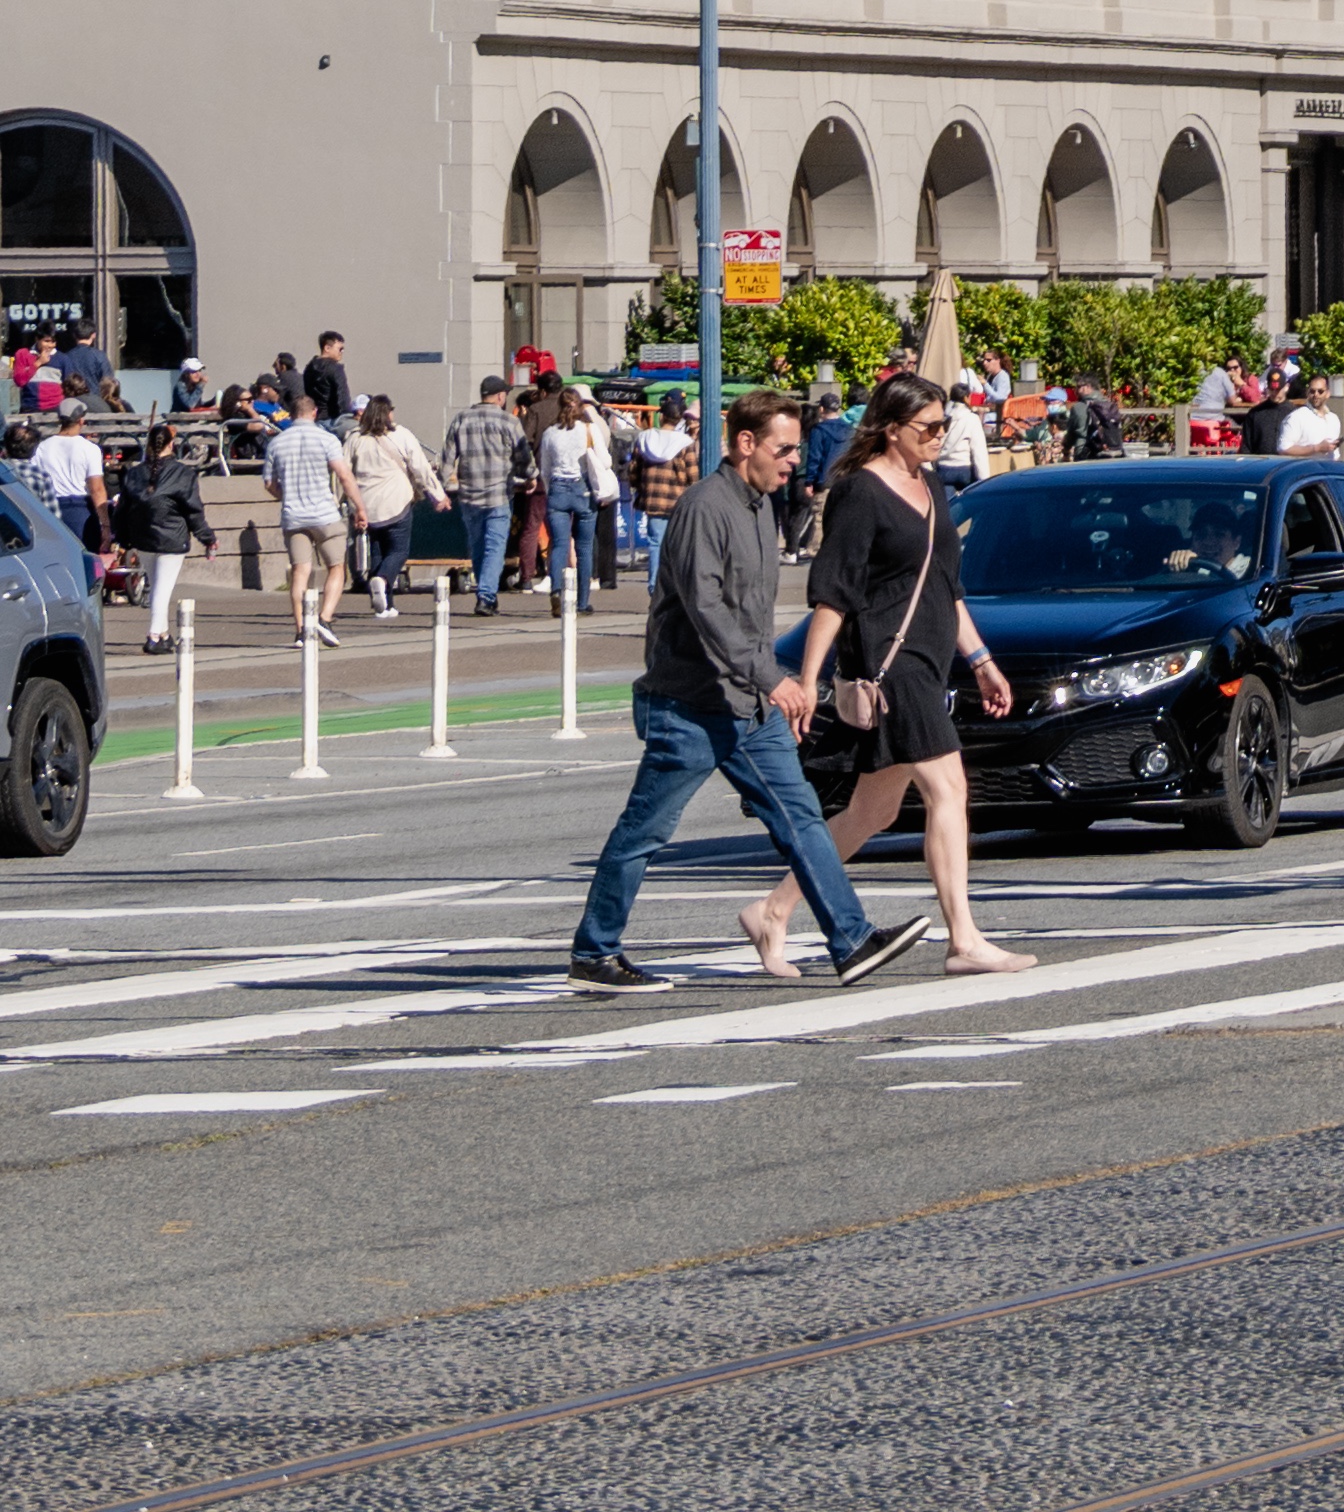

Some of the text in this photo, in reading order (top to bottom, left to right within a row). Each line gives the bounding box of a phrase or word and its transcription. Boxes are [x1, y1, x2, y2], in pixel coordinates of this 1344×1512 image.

[725, 248, 741, 262] NO
[735, 276, 770, 284] AT ALL
[739, 285, 766, 294] TIMES
[9, 302, 83, 321] GOTT'S
